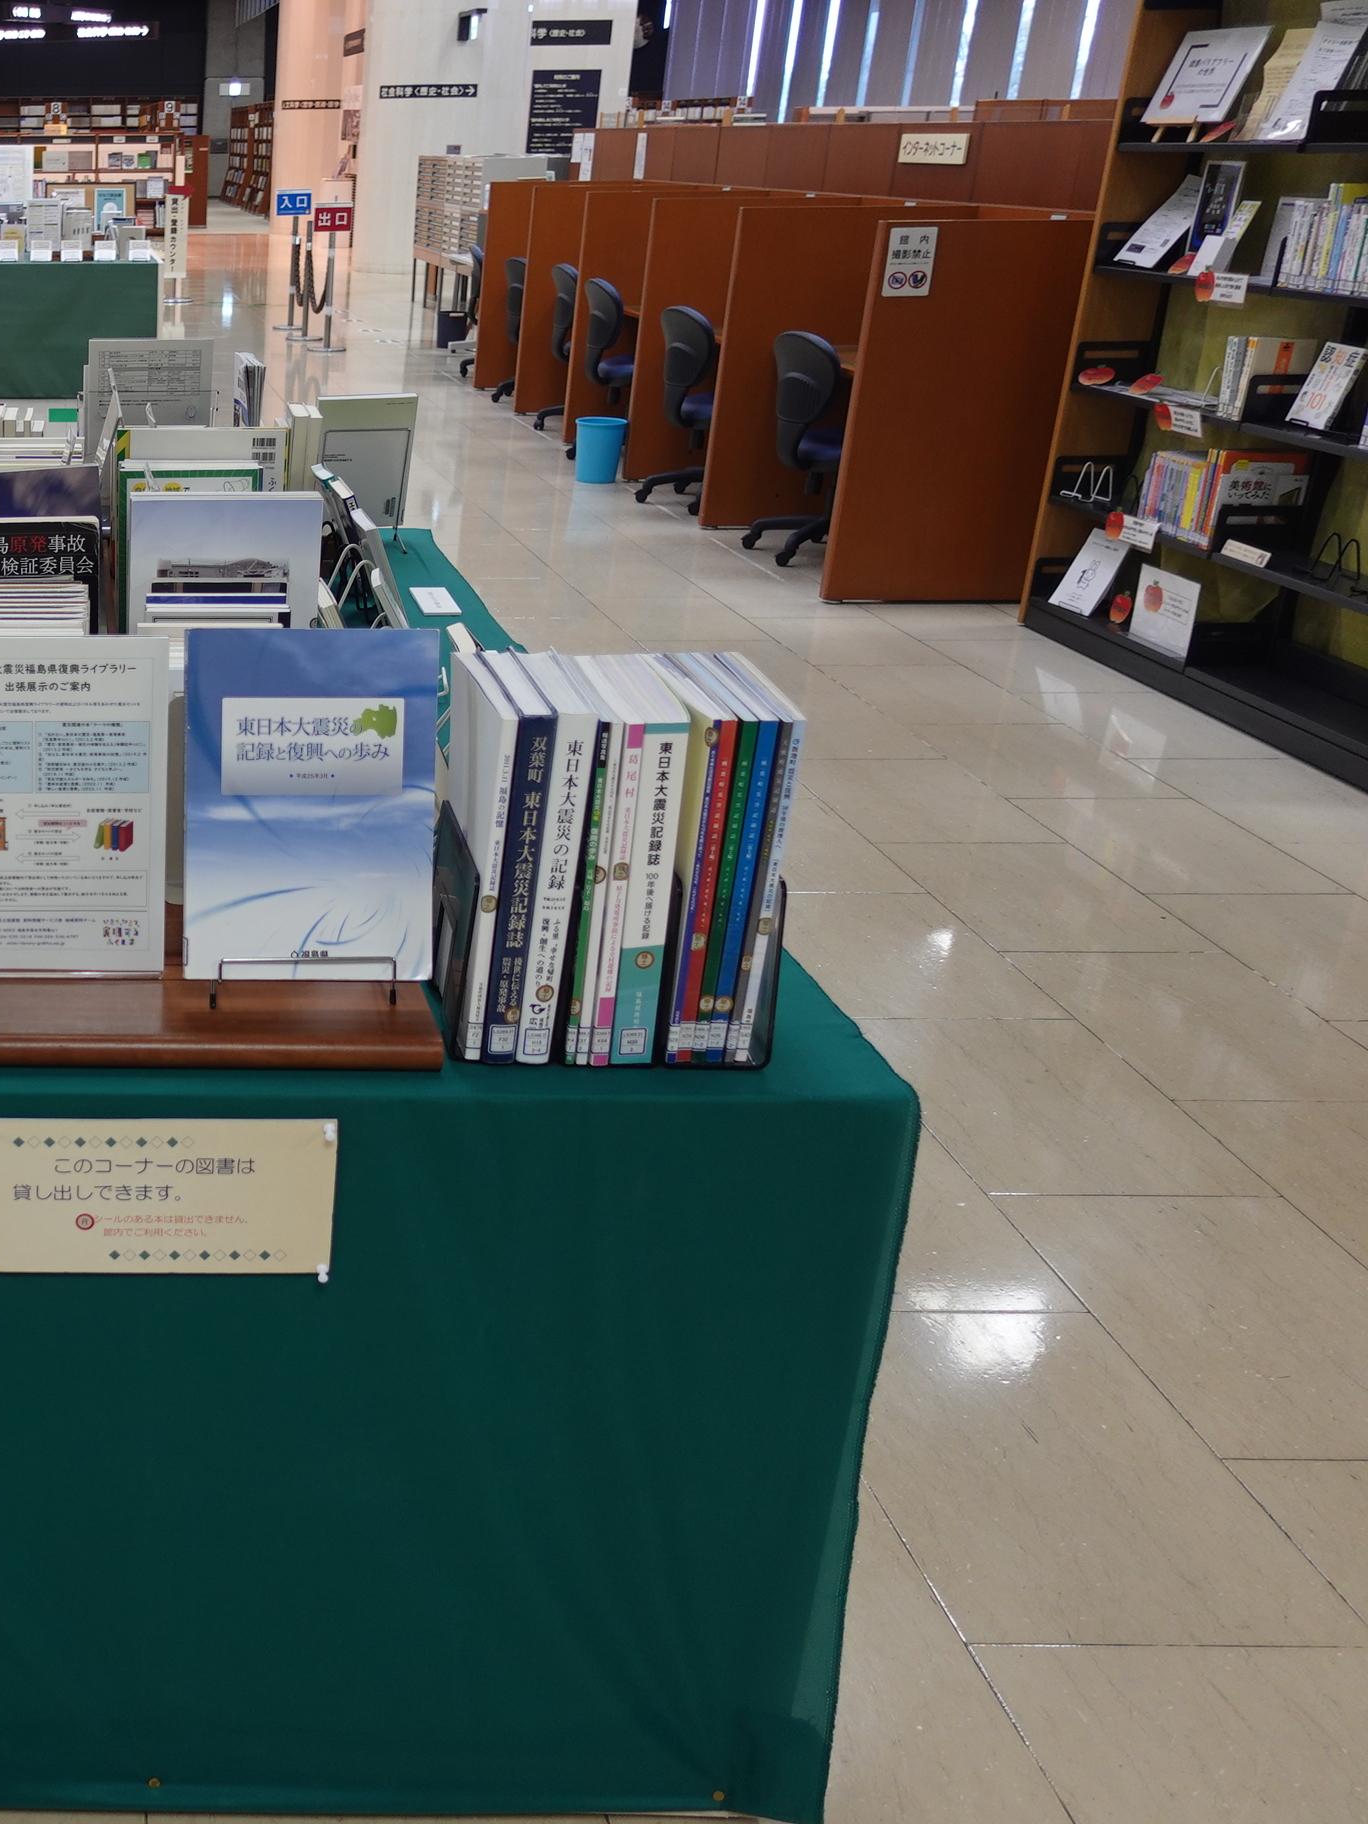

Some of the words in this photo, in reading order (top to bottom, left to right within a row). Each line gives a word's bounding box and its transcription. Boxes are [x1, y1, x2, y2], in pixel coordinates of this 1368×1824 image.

[53, 103, 60, 114] 8
[166, 102, 173, 113] 9
[902, 141, 962, 156] インターネットコーナー
[280, 196, 308, 209] 入口
[318, 212, 348, 227] 出口
[892, 249, 932, 259] 撮影禁止
[4, 682, 91, 692] 出張展示のご案内
[236, 716, 366, 737] 東日本大震災の
[236, 742, 390, 762] 記録と復興への歩み
[527, 736, 547, 783] 双葉町
[624, 754, 639, 800] 葛尾村
[647, 741, 672, 866] 東日本大震災記録誌
[547, 740, 584, 890] 東日本大震災の記録
[505, 791, 541, 948] 東日本大震災記録誌
[641, 873, 659, 939] 100年後へ届ける記録
[54, 1157, 255, 1176] このコーナーの図書は
[12, 1183, 184, 1202] 貸し出しできます。
[94, 1213, 249, 1226] シールのある本は貸出できません。
[103, 1227, 209, 1239] 館内でご利用ください。
